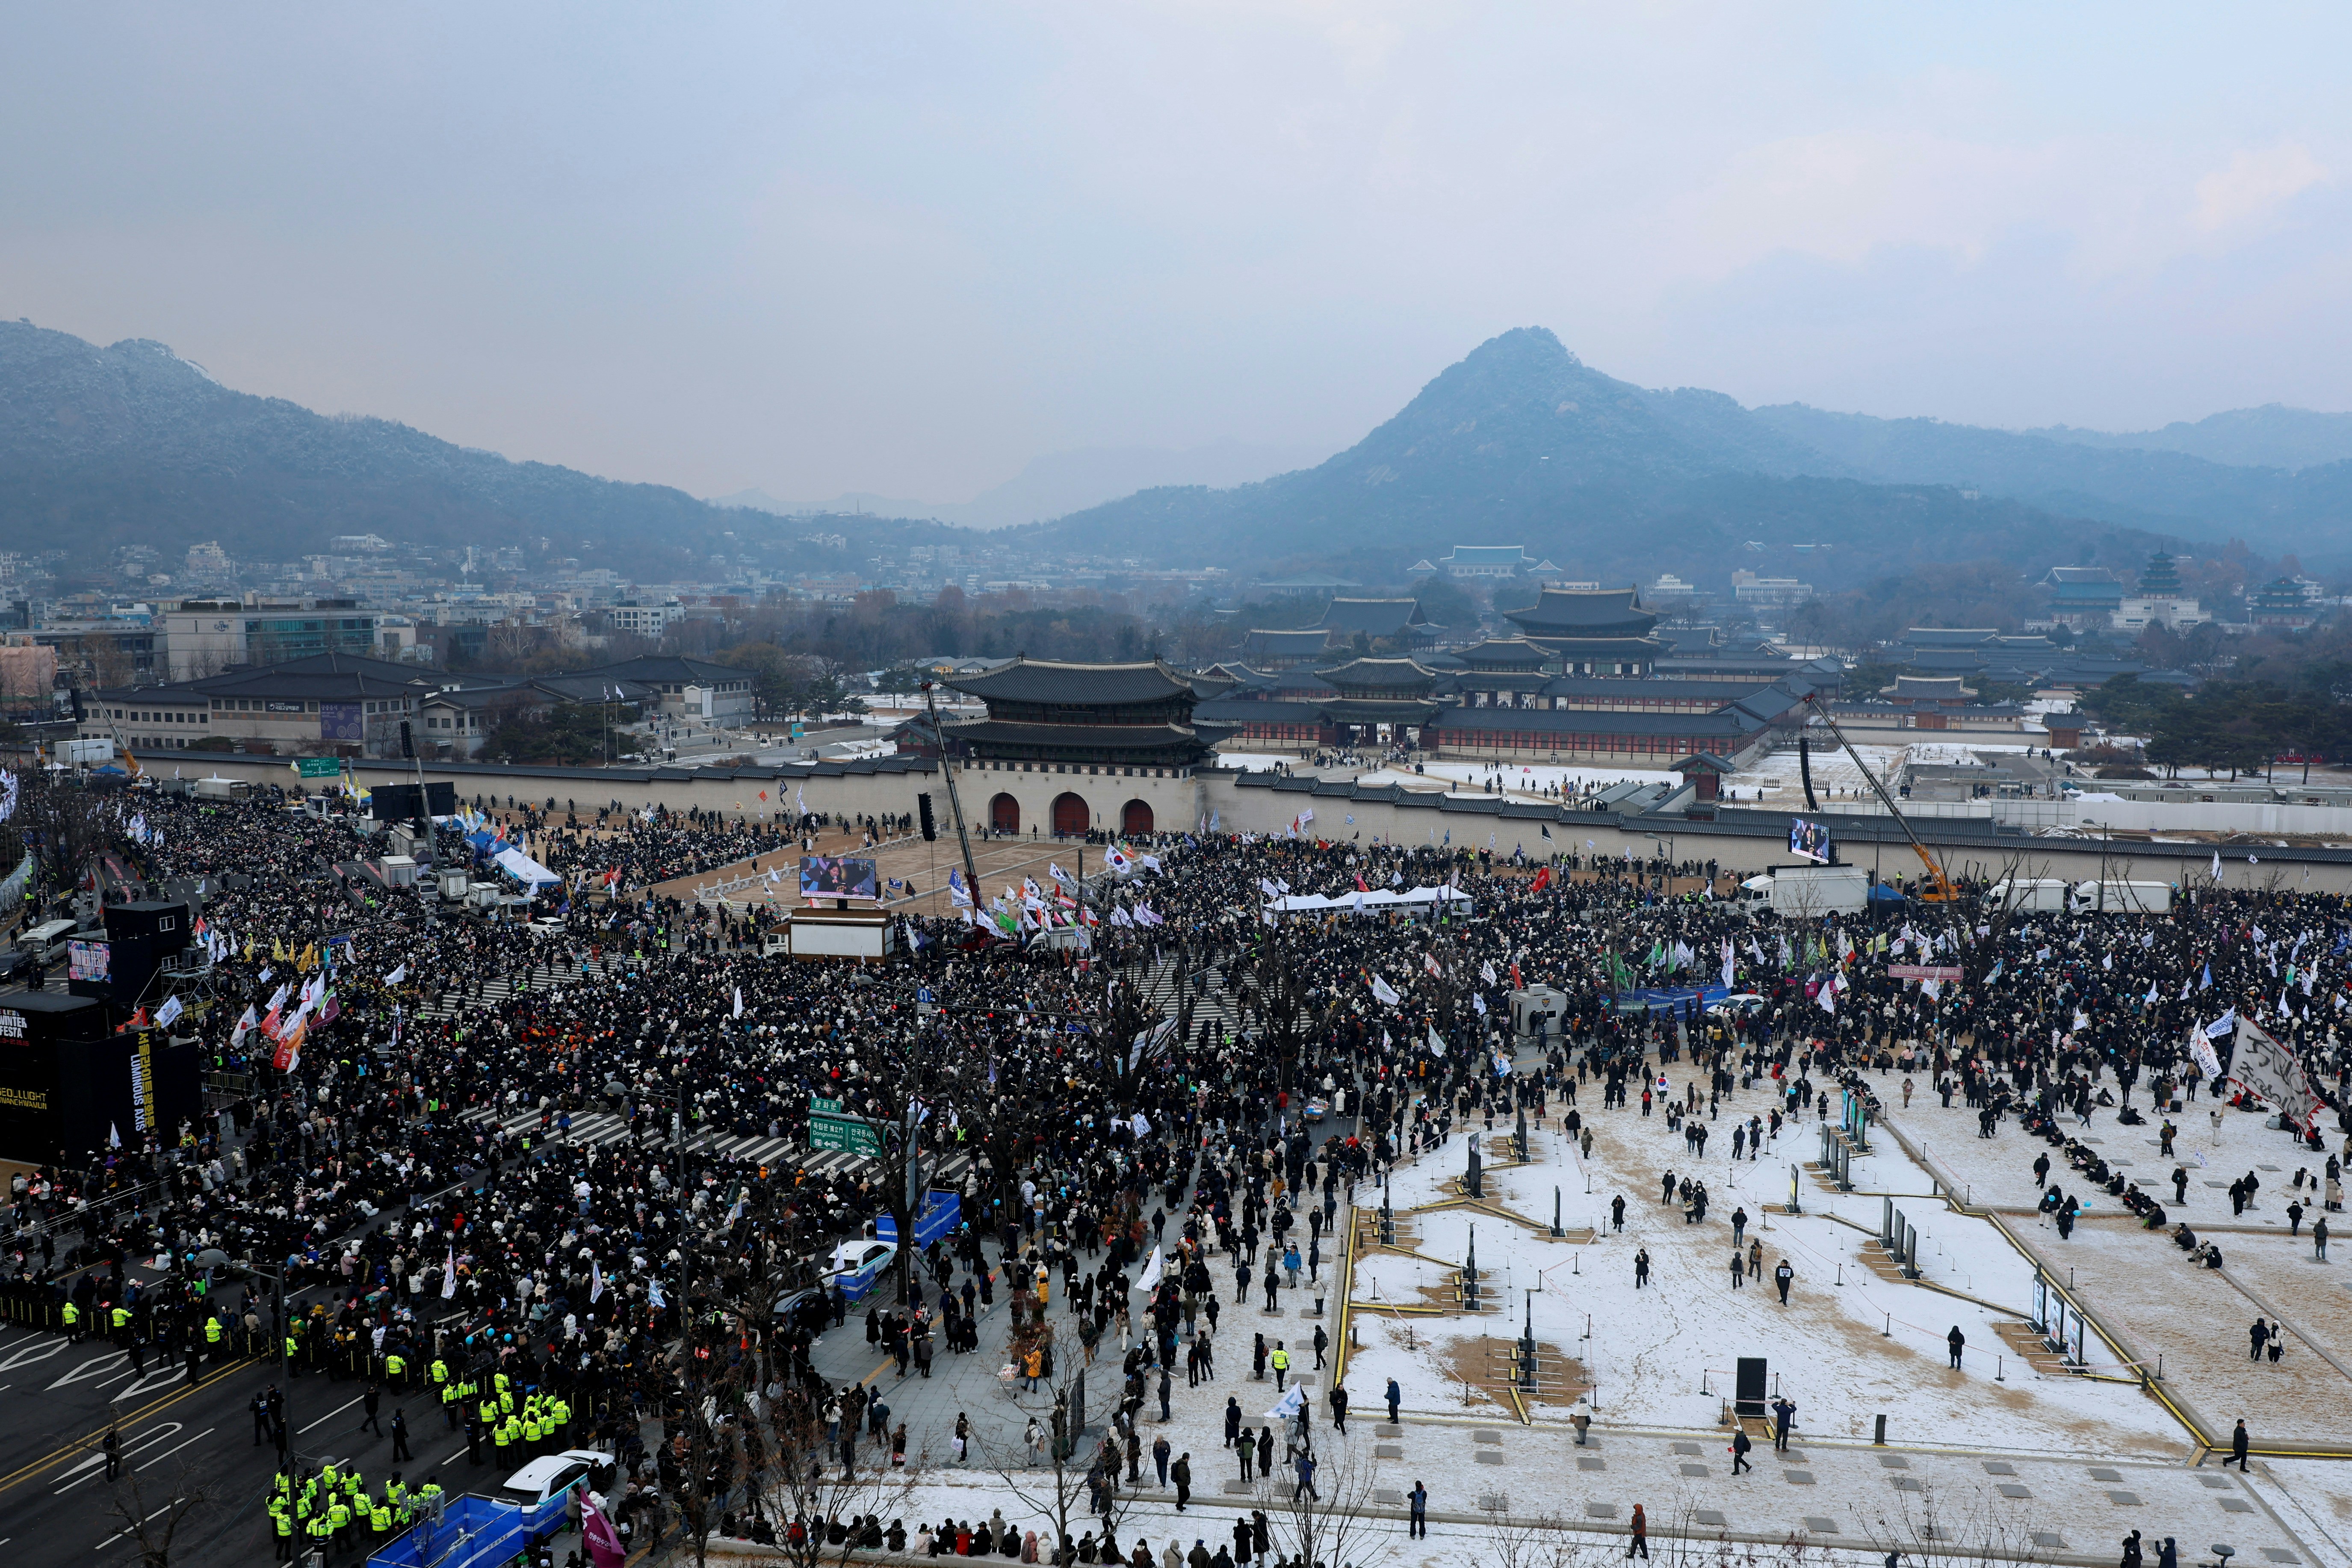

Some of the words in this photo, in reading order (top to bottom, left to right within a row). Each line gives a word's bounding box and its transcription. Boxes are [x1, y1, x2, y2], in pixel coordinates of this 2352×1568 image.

[71, 949, 90, 966] WINTER
[90, 951, 107, 969] FESTA
[0, 1025, 23, 1039] FESTA
[130, 1053, 144, 1106] LUMINOUS
[0, 1096, 47, 1110] WANGHWAMUN
[815, 1100, 837, 1110] 광화문
[134, 1108, 145, 1132] AXIS
[813, 1122, 829, 1131] 독립문
[813, 1130, 843, 1139] Dongnimmun
[851, 1128, 876, 1139] 안국동사거
